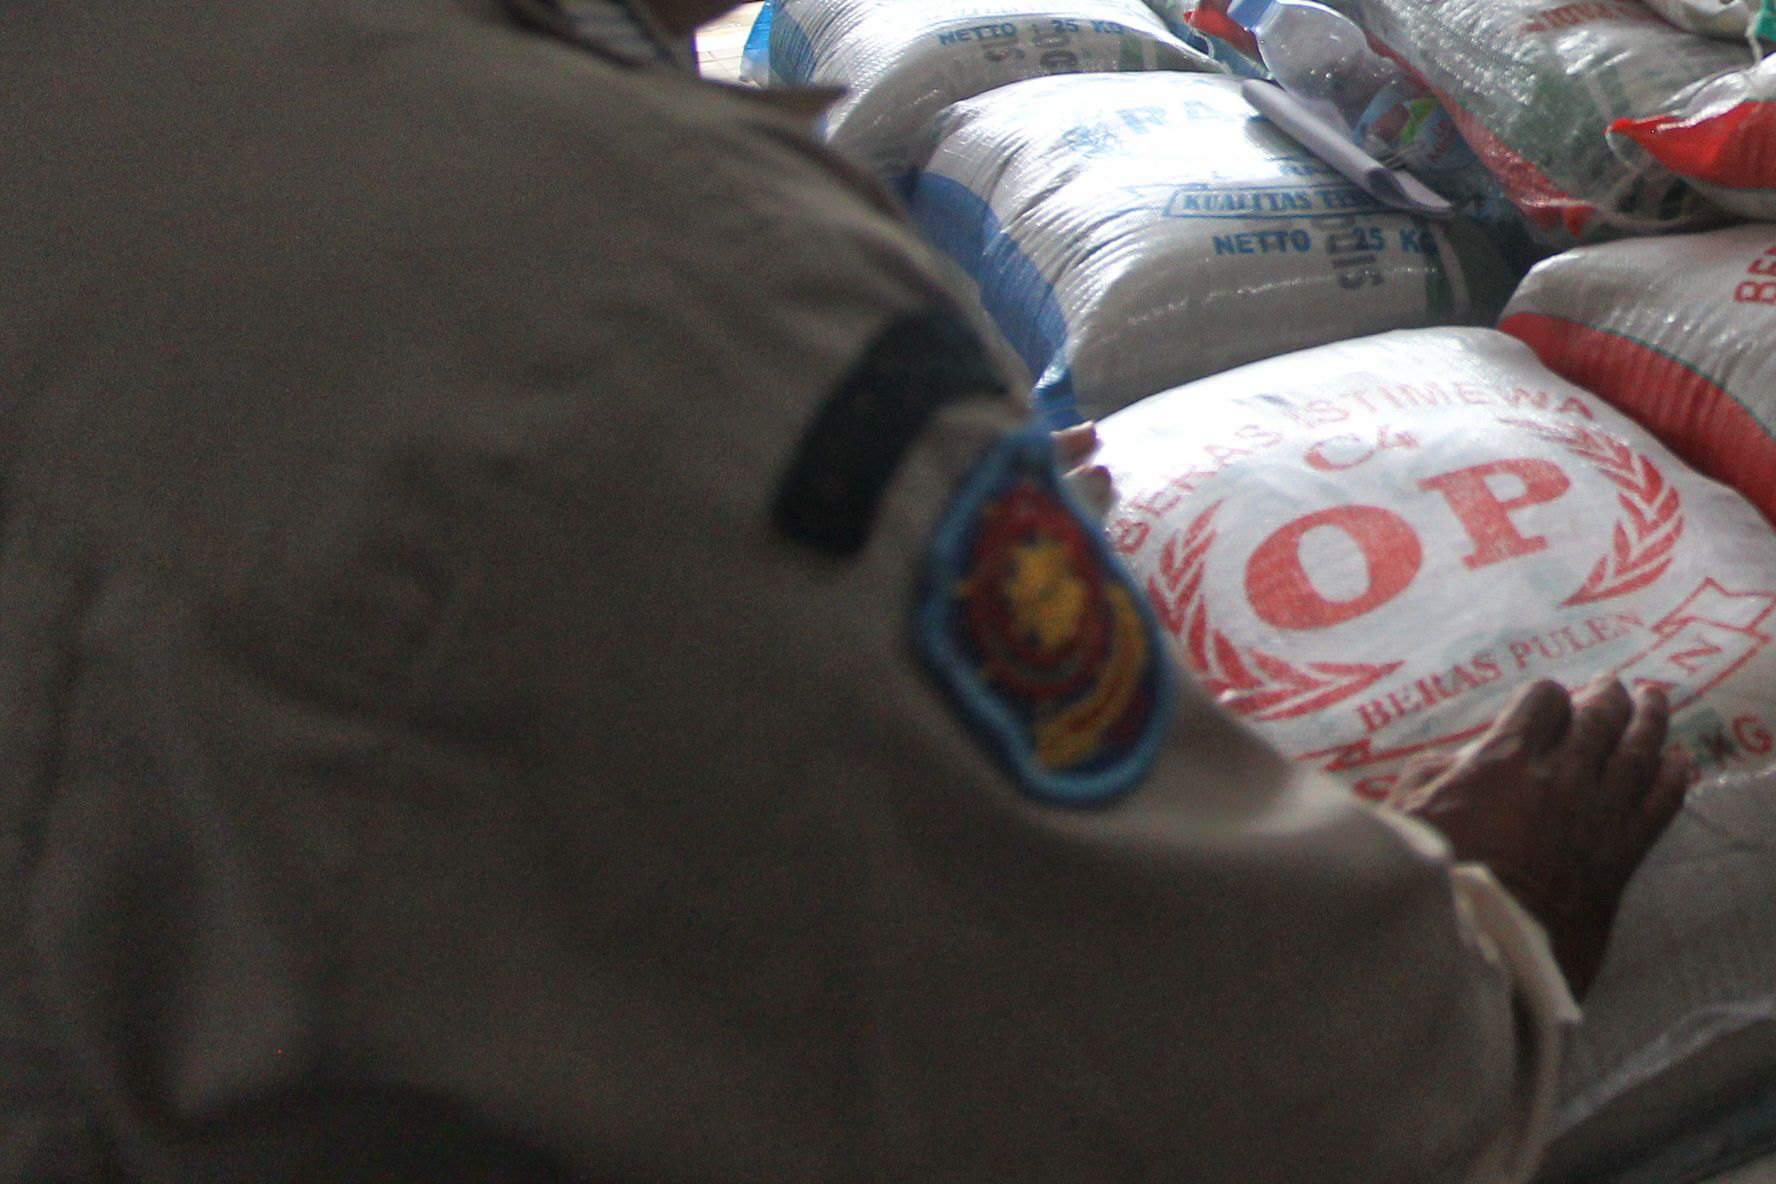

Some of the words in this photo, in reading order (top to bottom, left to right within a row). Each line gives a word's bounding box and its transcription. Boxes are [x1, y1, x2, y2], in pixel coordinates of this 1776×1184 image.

[938, 22, 1019, 46] NETTO
[1050, 19, 1080, 33] 25
[1183, 192, 1313, 212] KUALITAS
[1212, 229, 1312, 256] NETTO
[1350, 226, 1385, 251] 25
[1113, 423, 1286, 557] BERAS
[1284, 381, 1597, 425] ISTIMEWA
[1244, 457, 1570, 631] OP
[1354, 652, 1502, 733] BERAS
[1508, 613, 1645, 670] PULEN
